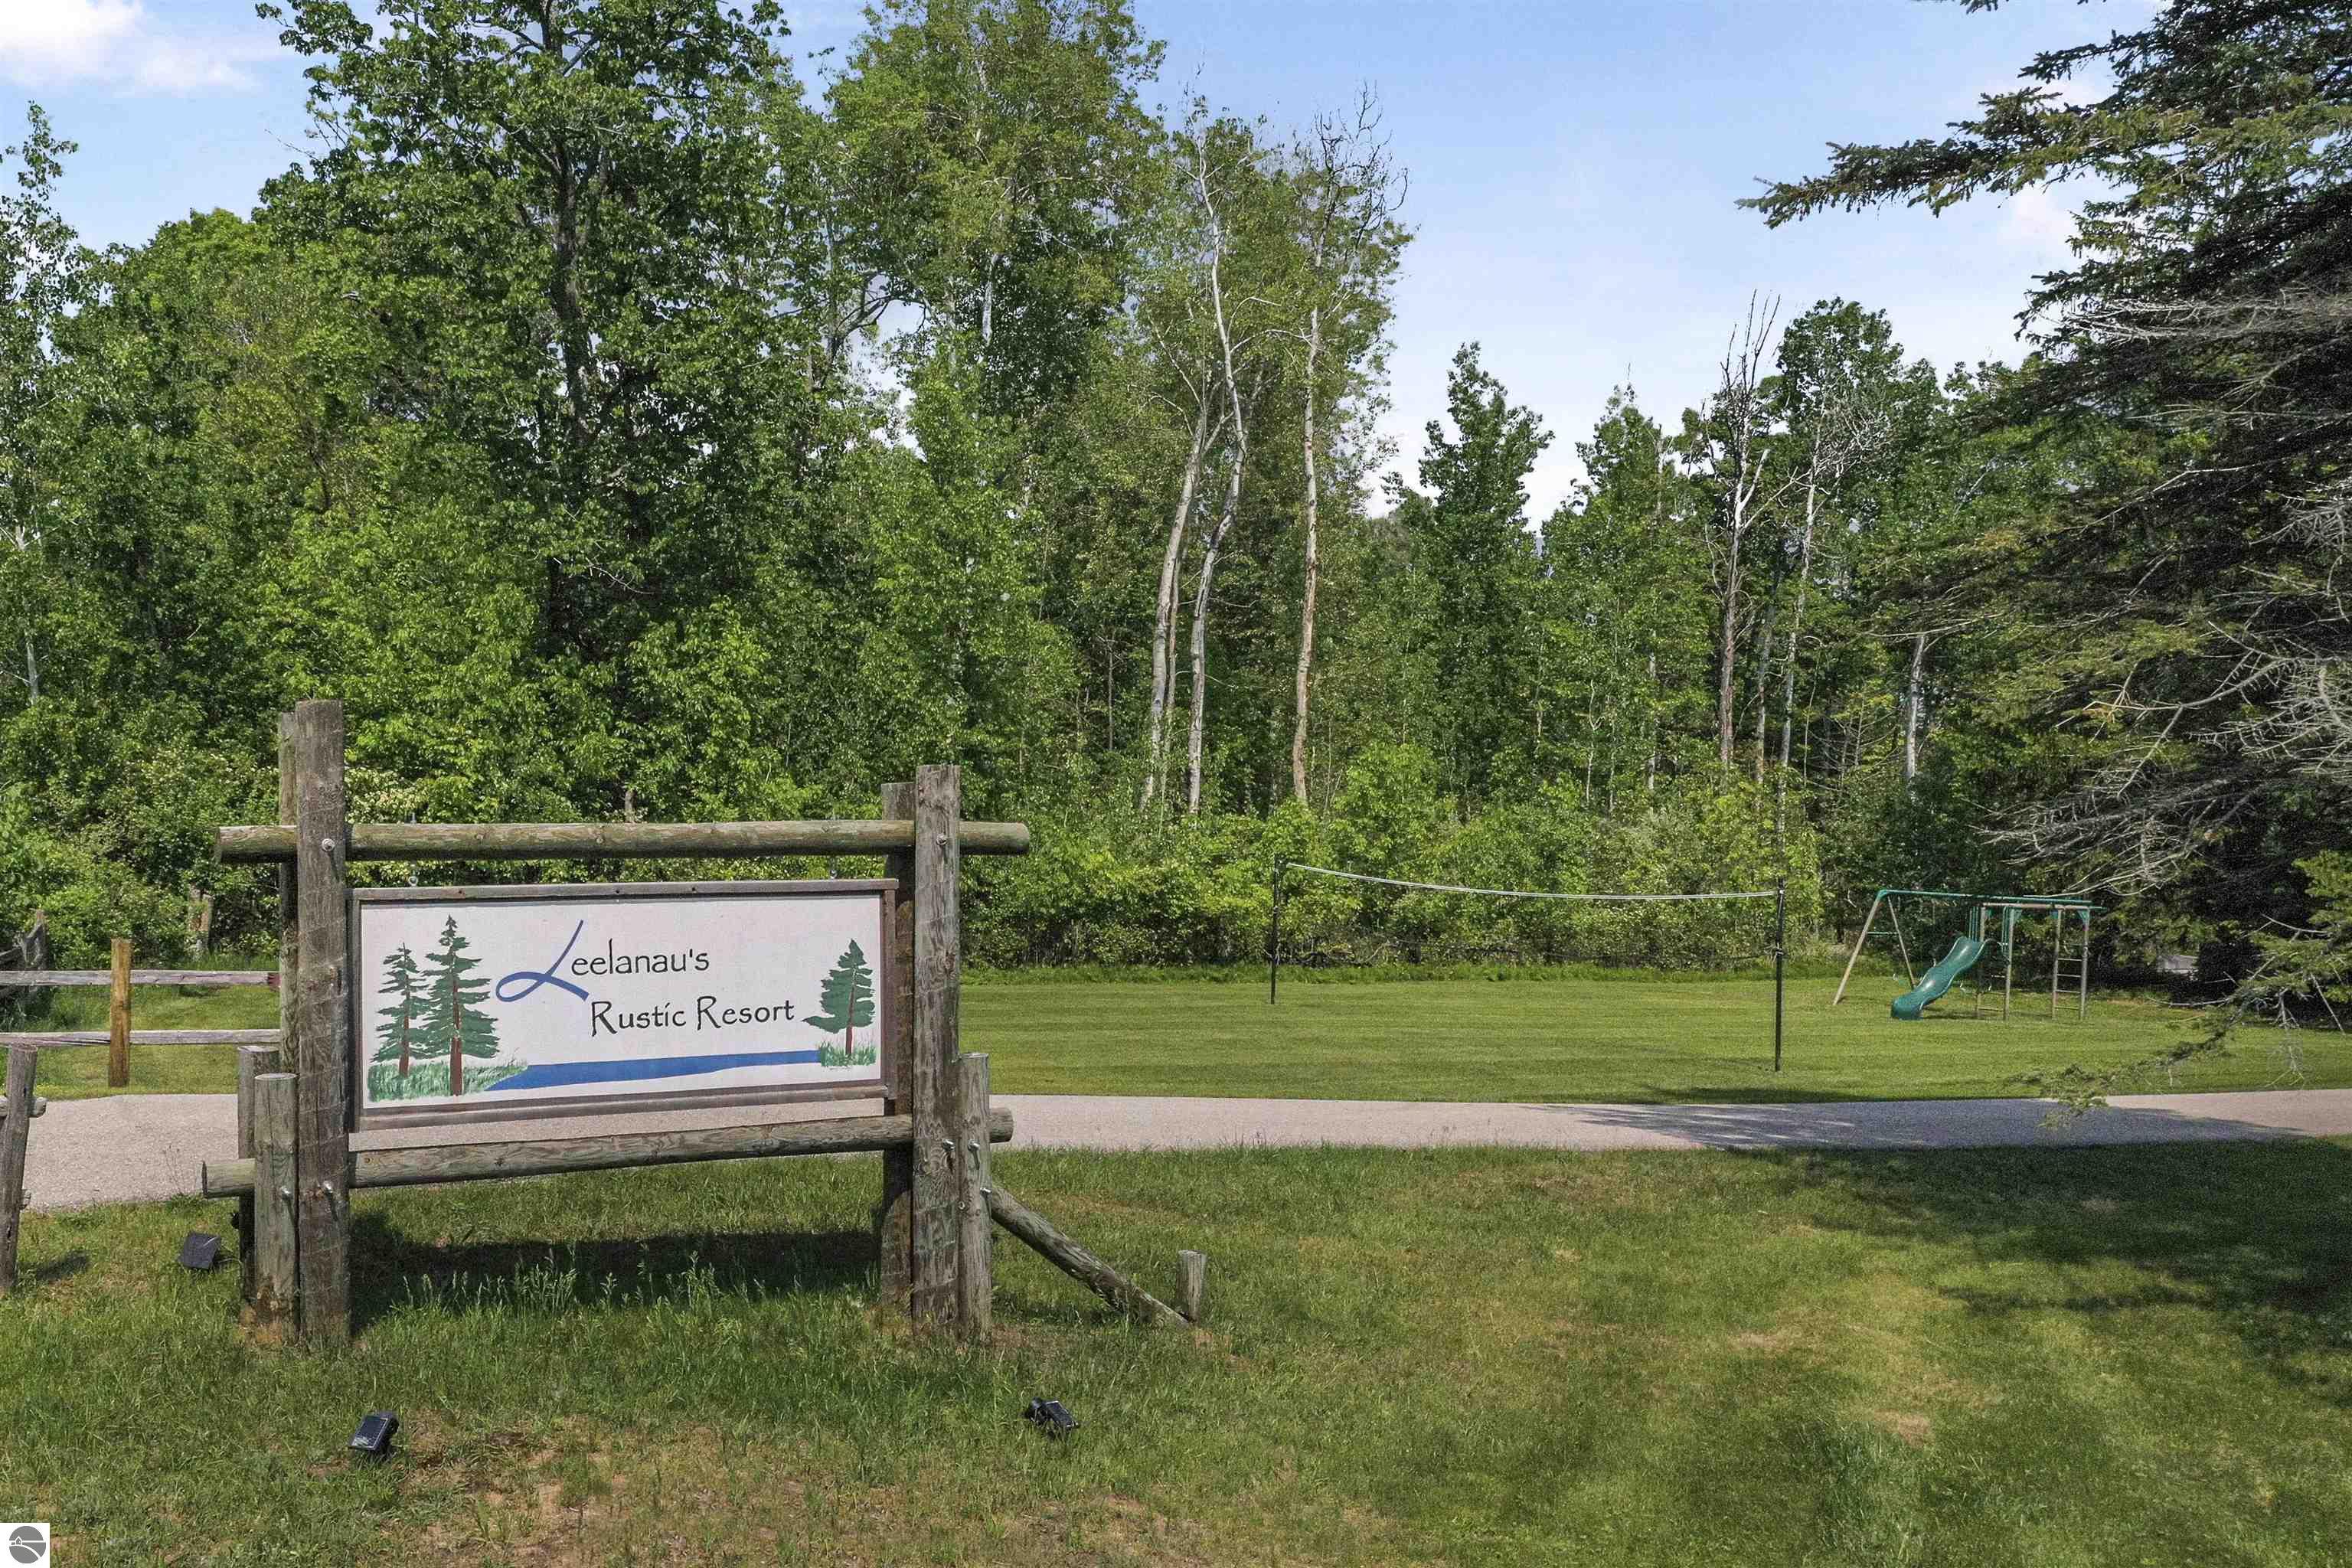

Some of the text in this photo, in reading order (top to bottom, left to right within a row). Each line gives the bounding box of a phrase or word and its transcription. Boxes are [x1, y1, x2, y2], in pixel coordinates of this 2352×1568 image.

[496, 920, 710, 1002] Leelanau's
[590, 995, 795, 1037] Rustic Resort
